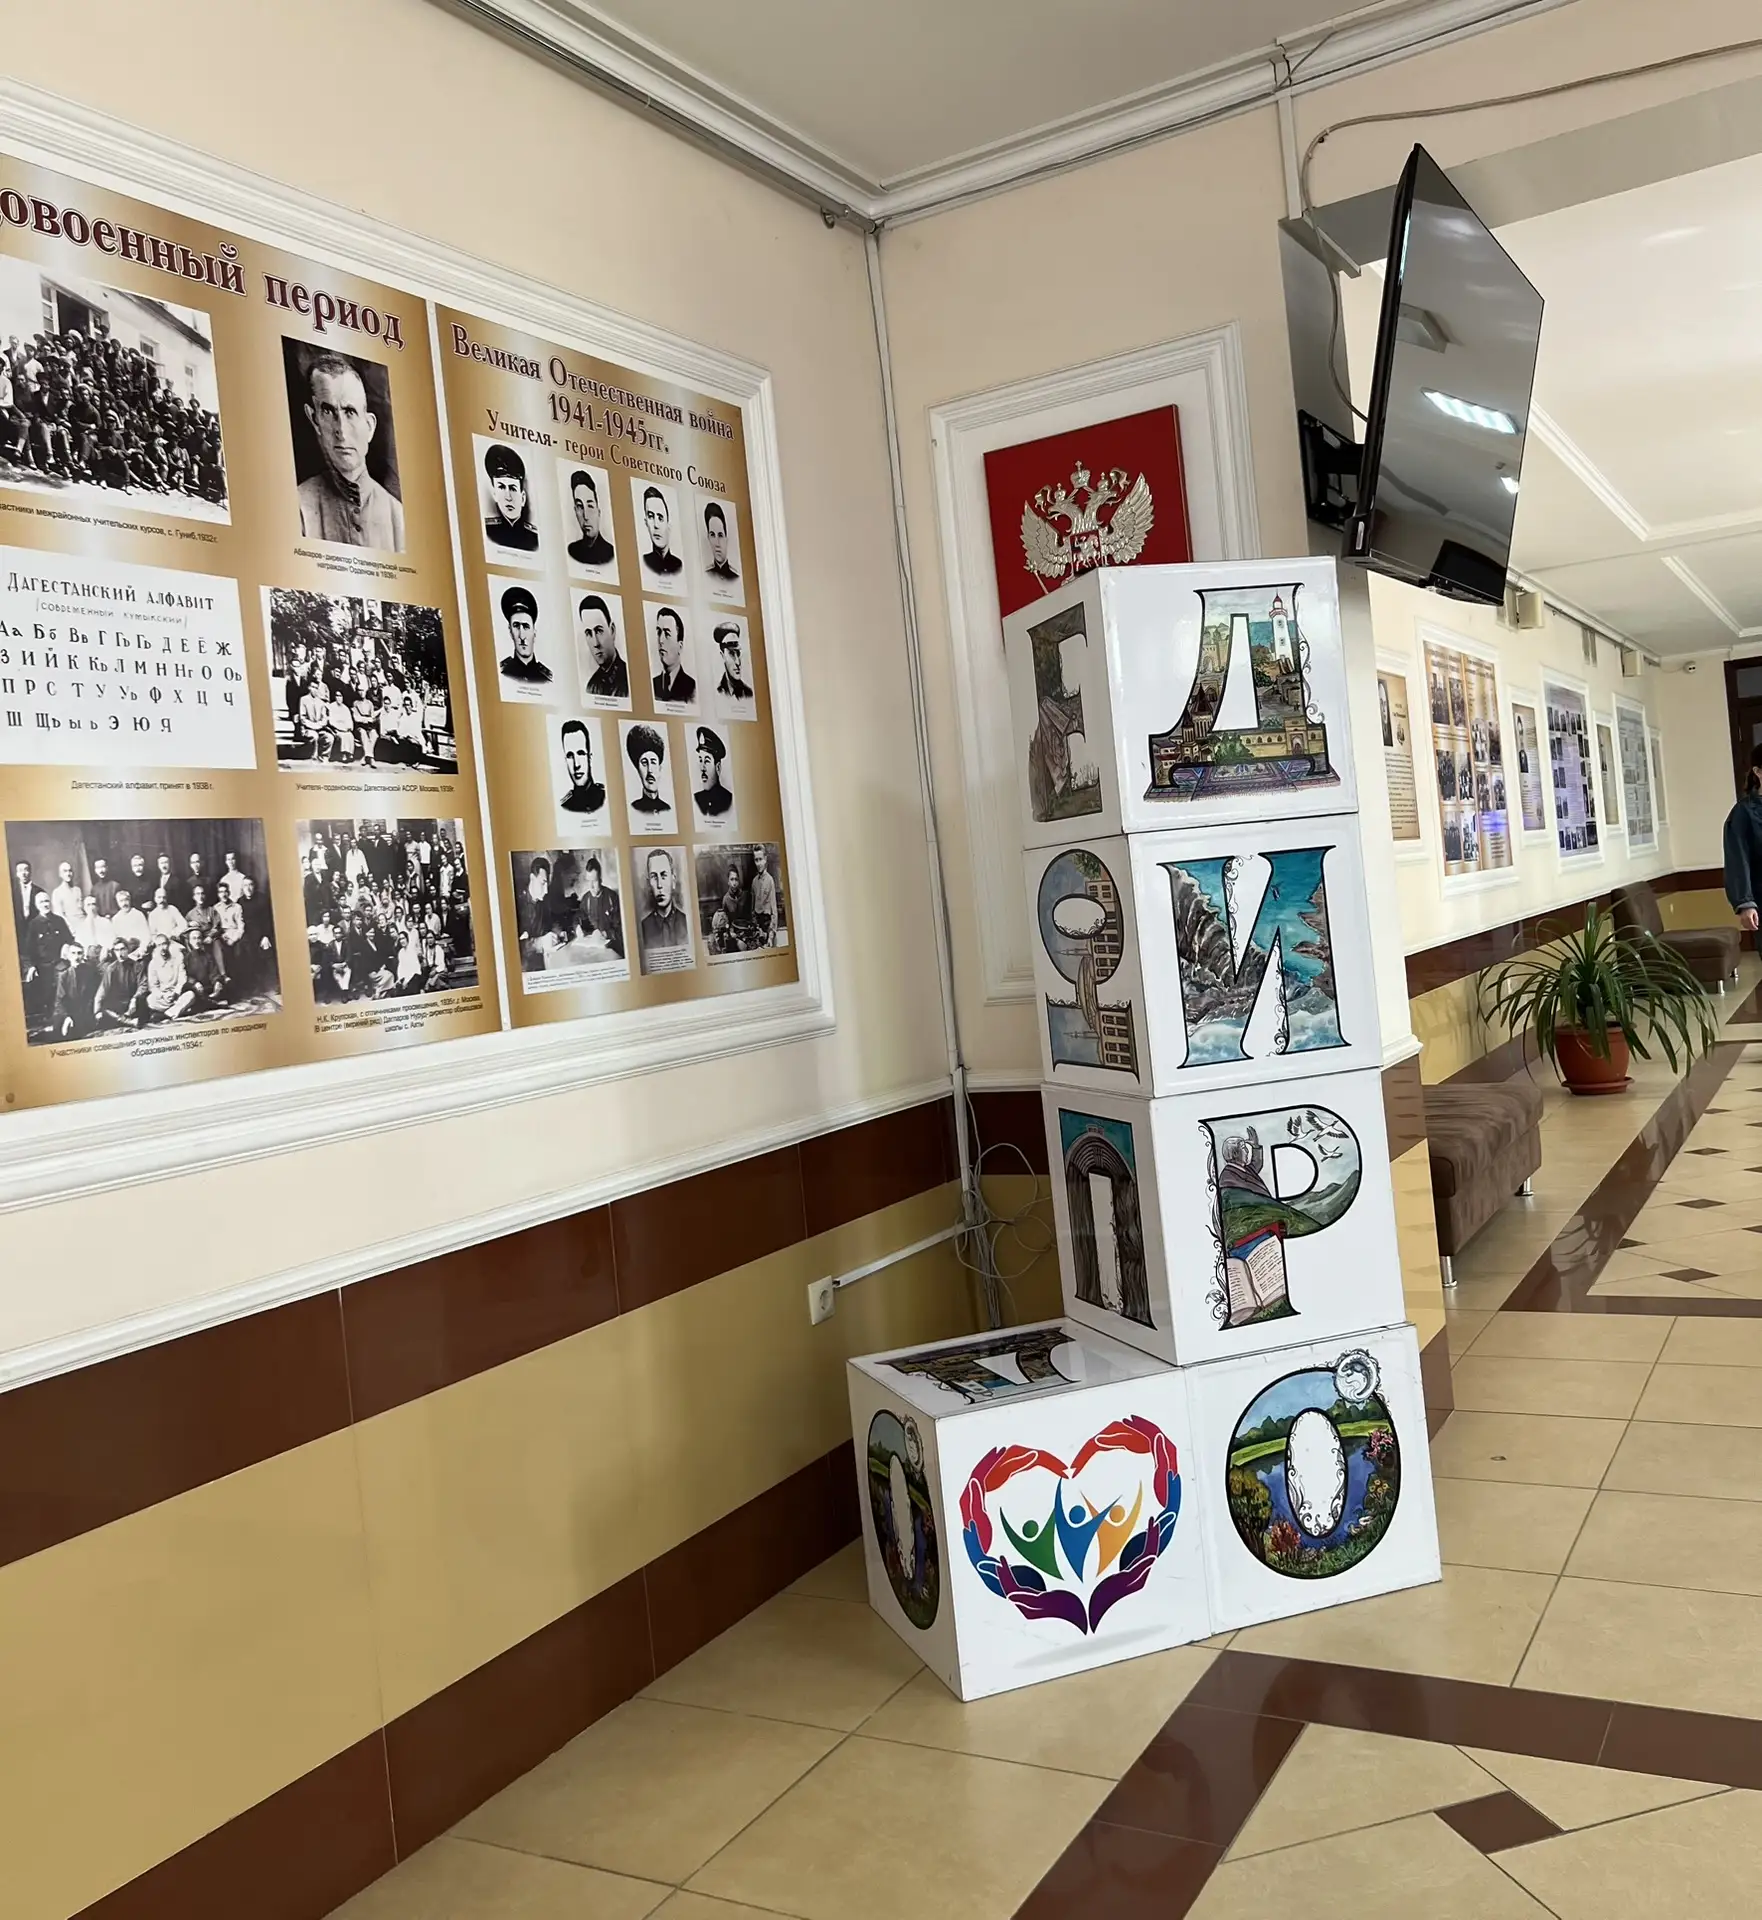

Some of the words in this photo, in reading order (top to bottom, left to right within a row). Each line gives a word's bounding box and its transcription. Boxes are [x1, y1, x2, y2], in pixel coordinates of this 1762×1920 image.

[0, 187, 247, 297] овоенный
[262, 272, 406, 351] период
[451, 322, 543, 382] Великая
[549, 355, 684, 426] Отечественная
[688, 407, 736, 442] война
[548, 391, 670, 454] 1941-1945гг.
[565, 439, 605, 461] герои
[610, 443, 683, 482] Советского
[687, 465, 727, 494] Союза
[92, 516, 139, 531] учительских
[146, 591, 214, 610] АЛФАВИТ
[22, 650, 35, 666] И
[45, 647, 58, 668] Й
[67, 654, 79, 670] К
[114, 659, 125, 673] Л
[135, 660, 147, 675] М
[156, 662, 167, 676] Н
[202, 665, 212, 680] О
[98, 630, 107, 645] Г
[162, 637, 172, 654] Д
[181, 638, 190, 653] Е
[215, 641, 232, 656] Ж
[2, 678, 15, 694] П
[25, 679, 36, 695] Р
[46, 681, 57, 697] С
[71, 682, 84, 698] Т
[96, 683, 106, 698] У
[149, 686, 162, 704] Ф
[173, 689, 183, 704] Х
[197, 690, 207, 706] Ц
[224, 692, 234, 706] Ч
[1144, 582, 1336, 796] Д
[6, 711, 22, 727] Ш
[108, 715, 119, 730] Э
[133, 716, 150, 732] Ю
[161, 717, 172, 733] Я
[71, 780, 122, 790] Дагестанский
[1156, 844, 1353, 1069] И
[49, 1047, 92, 1058] Участники
[138, 1035, 174, 1047] окружных
[175, 1028, 219, 1041] инспекторов
[231, 1022, 267, 1034] народному
[1058, 1107, 1158, 1331] П
[1199, 1103, 1363, 1331] Р
[1225, 1356, 1402, 1580] О
